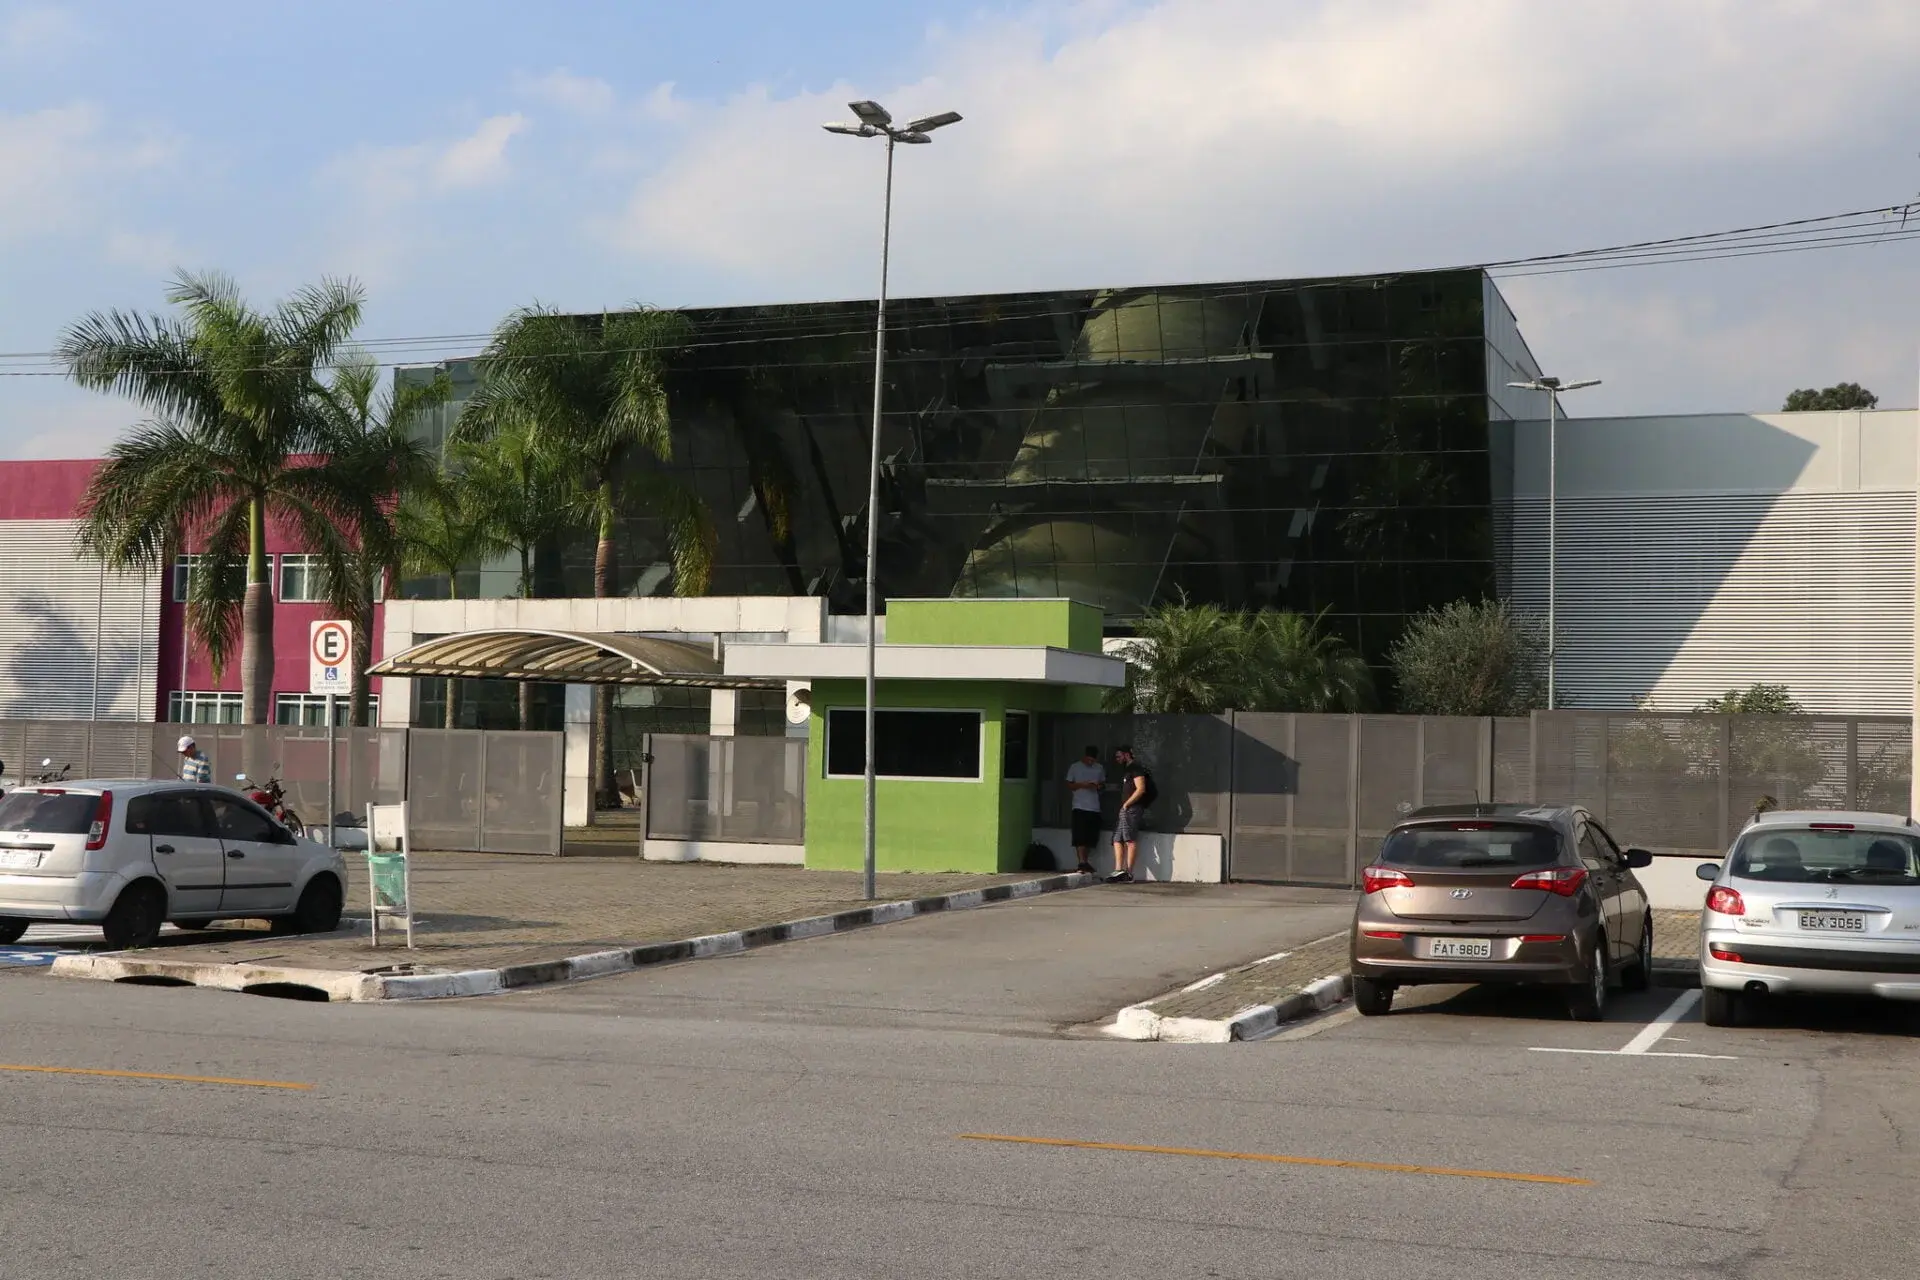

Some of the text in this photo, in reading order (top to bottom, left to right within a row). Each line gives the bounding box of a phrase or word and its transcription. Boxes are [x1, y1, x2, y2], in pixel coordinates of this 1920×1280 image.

[325, 632, 337, 657] E
[1801, 916, 1862, 930] EEX 3055
